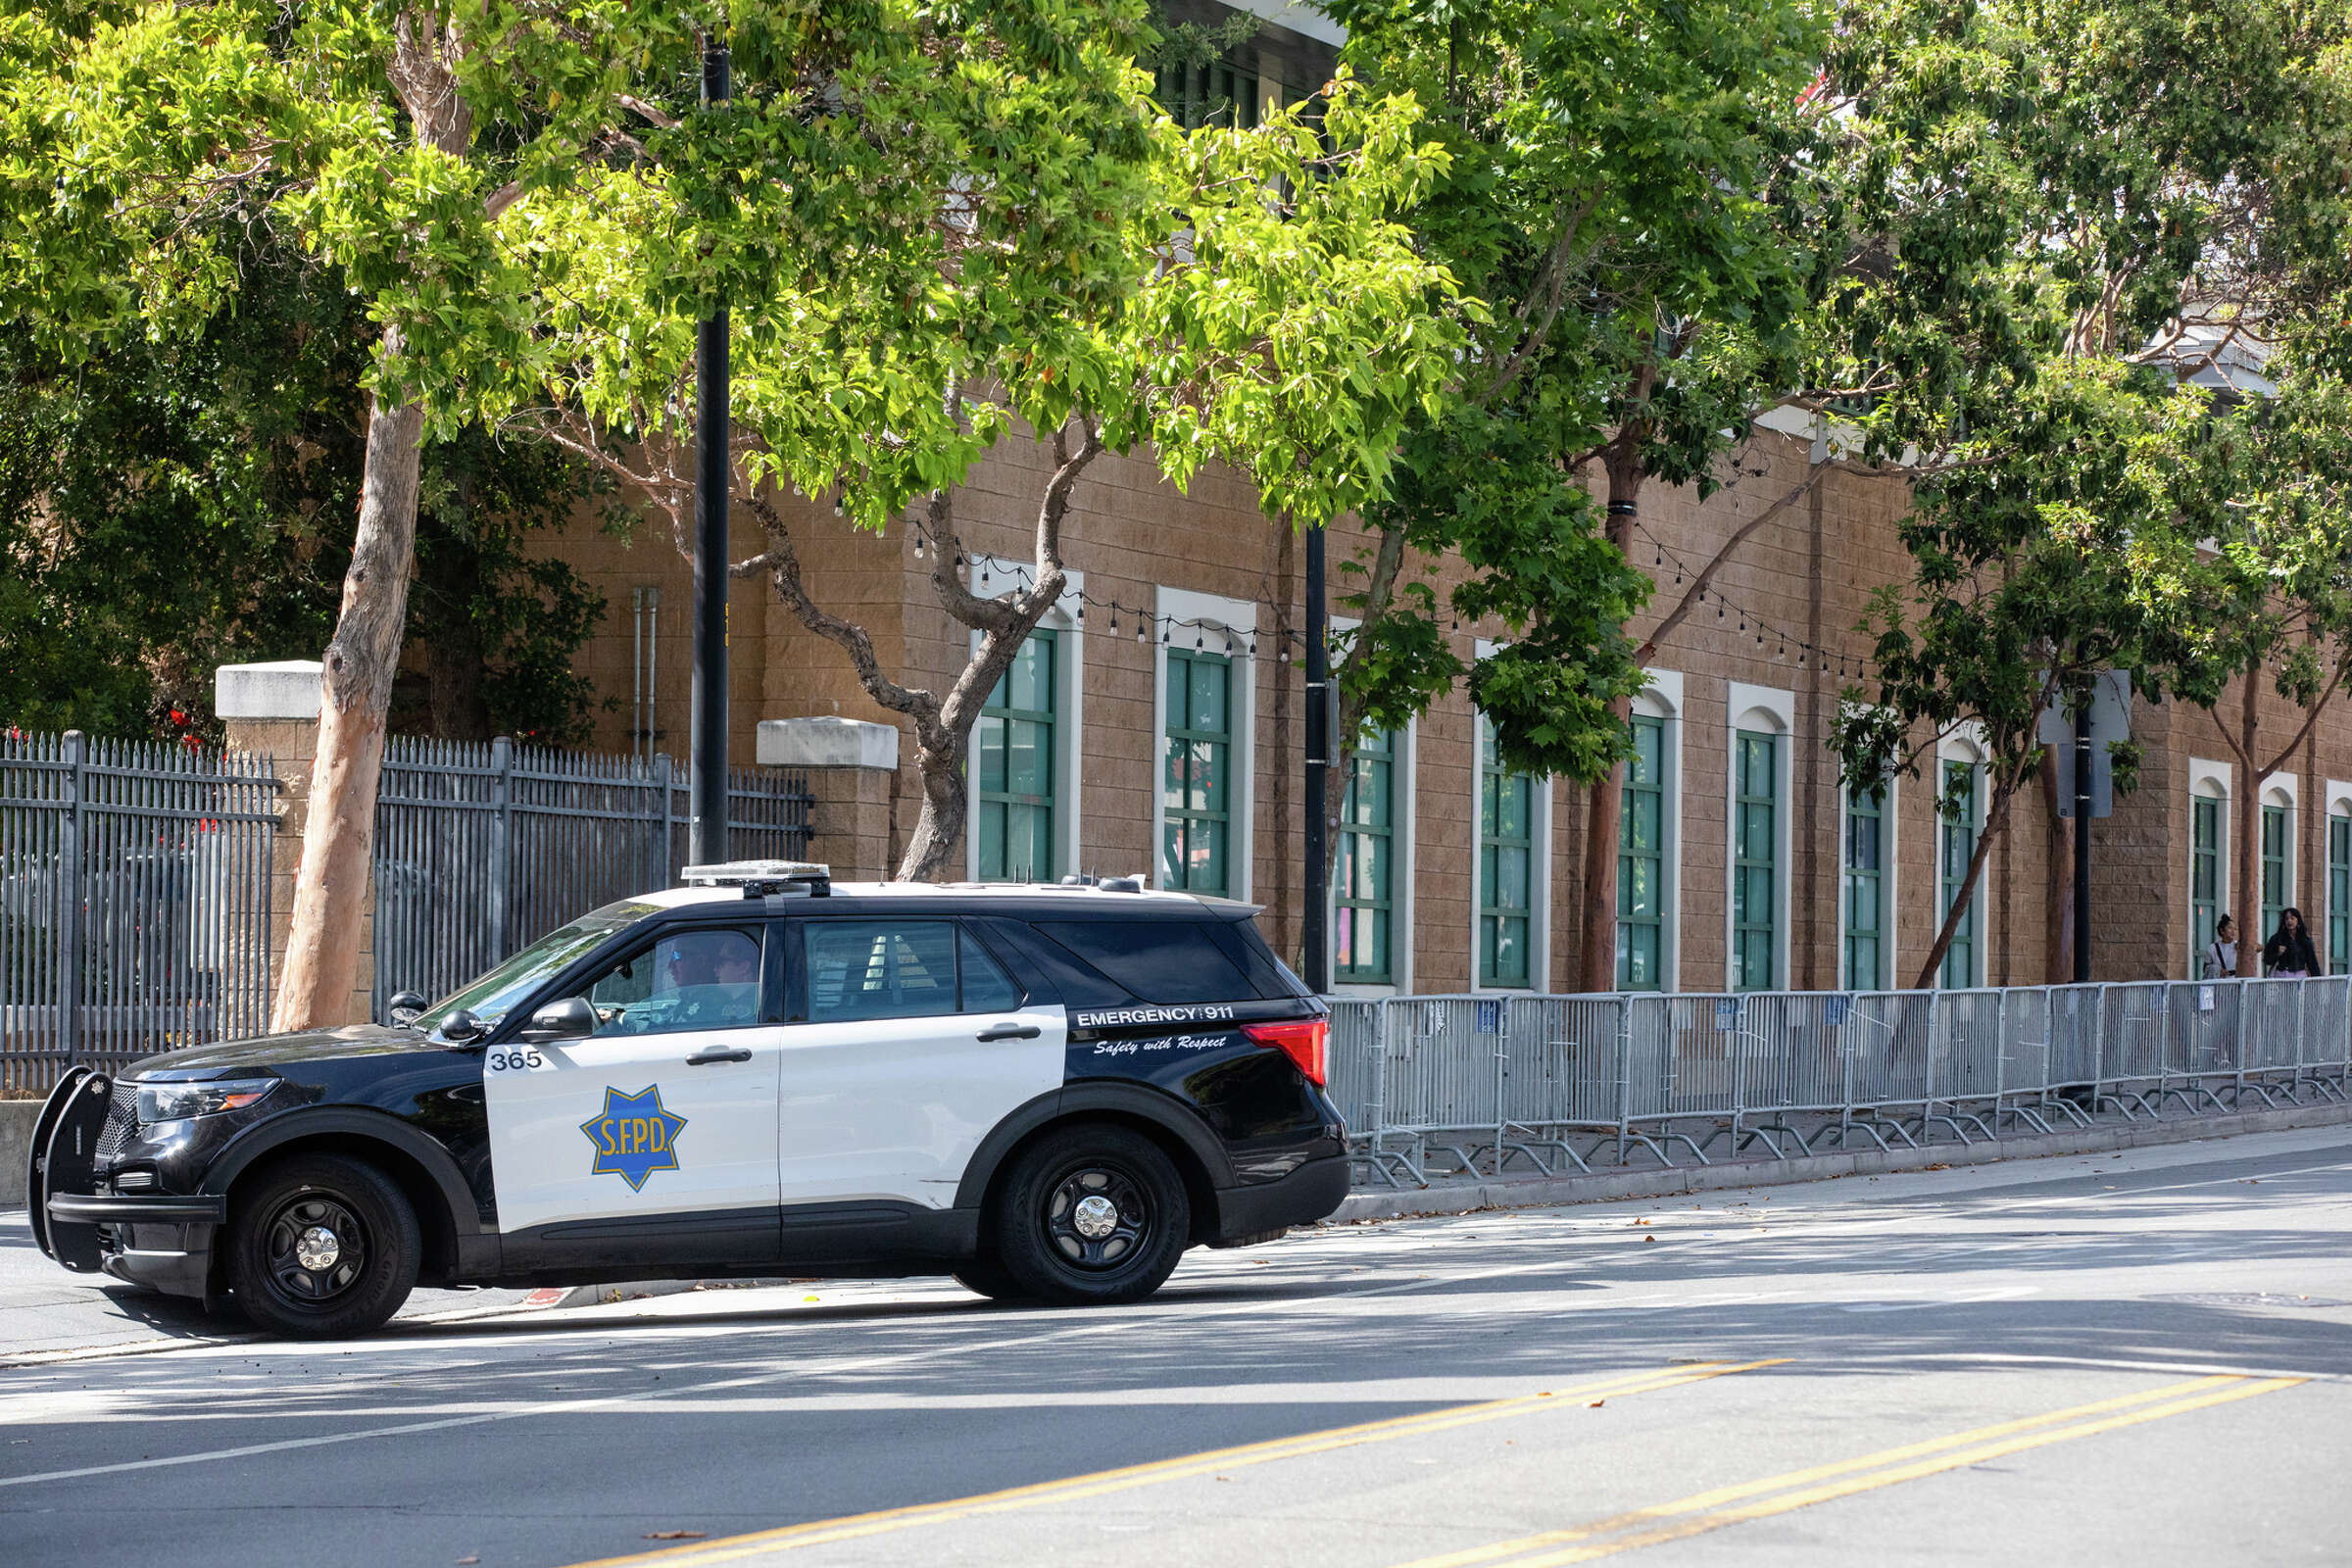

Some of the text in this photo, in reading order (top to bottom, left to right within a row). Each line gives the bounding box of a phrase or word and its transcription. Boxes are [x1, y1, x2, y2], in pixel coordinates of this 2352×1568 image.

[1077, 1007, 1197, 1027] EMERGENCY
[1204, 1005, 1235, 1019] 911
[1094, 1035, 1227, 1056] Safety with Respect
[491, 1051, 542, 1071] 365
[601, 1116, 668, 1155] S.F.P.D.
